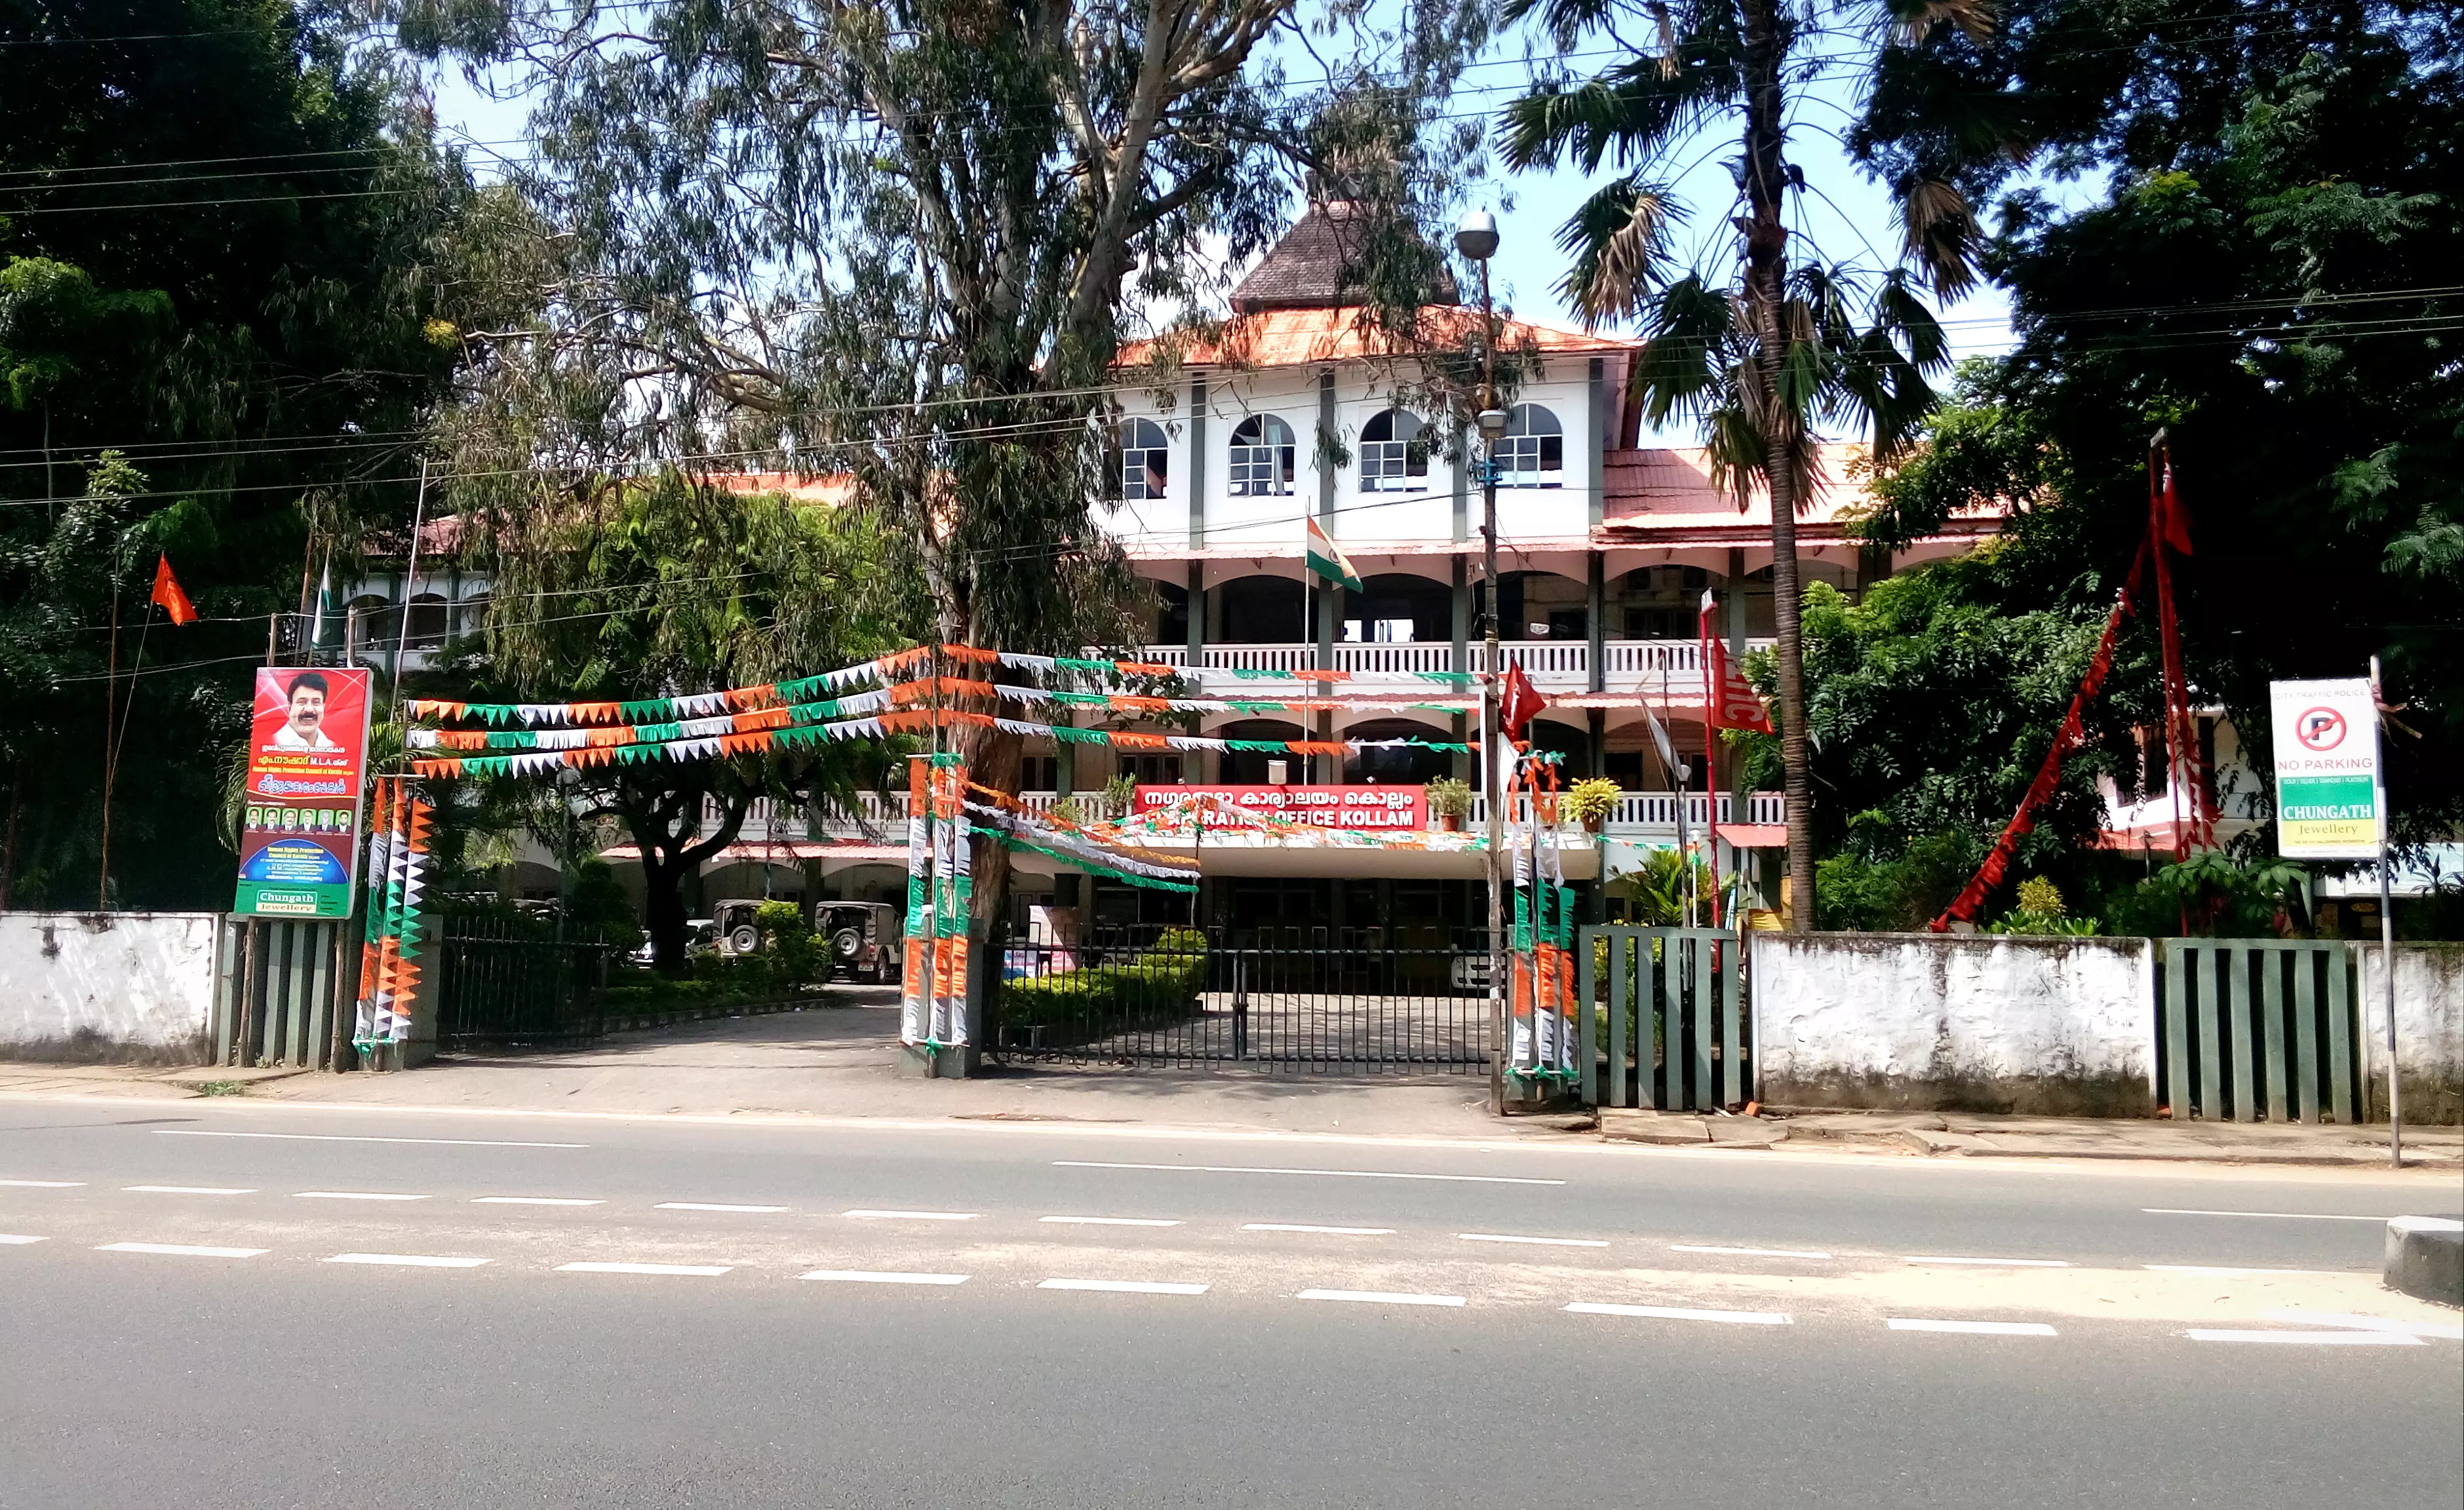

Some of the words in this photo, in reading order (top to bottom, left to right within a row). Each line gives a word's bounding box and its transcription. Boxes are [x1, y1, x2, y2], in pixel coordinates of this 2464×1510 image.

[2334, 689, 2366, 697] POLICE
[2278, 760, 2299, 770] NO
[2305, 758, 2372, 769] PARKING
[1344, 792, 1413, 809] കൊല്ലം
[2284, 804, 2372, 819] CHUNGATH
[1340, 810, 1413, 826] KOLLAM
[2298, 824, 2358, 835] Jewellery
[260, 892, 313, 903] Chungath
